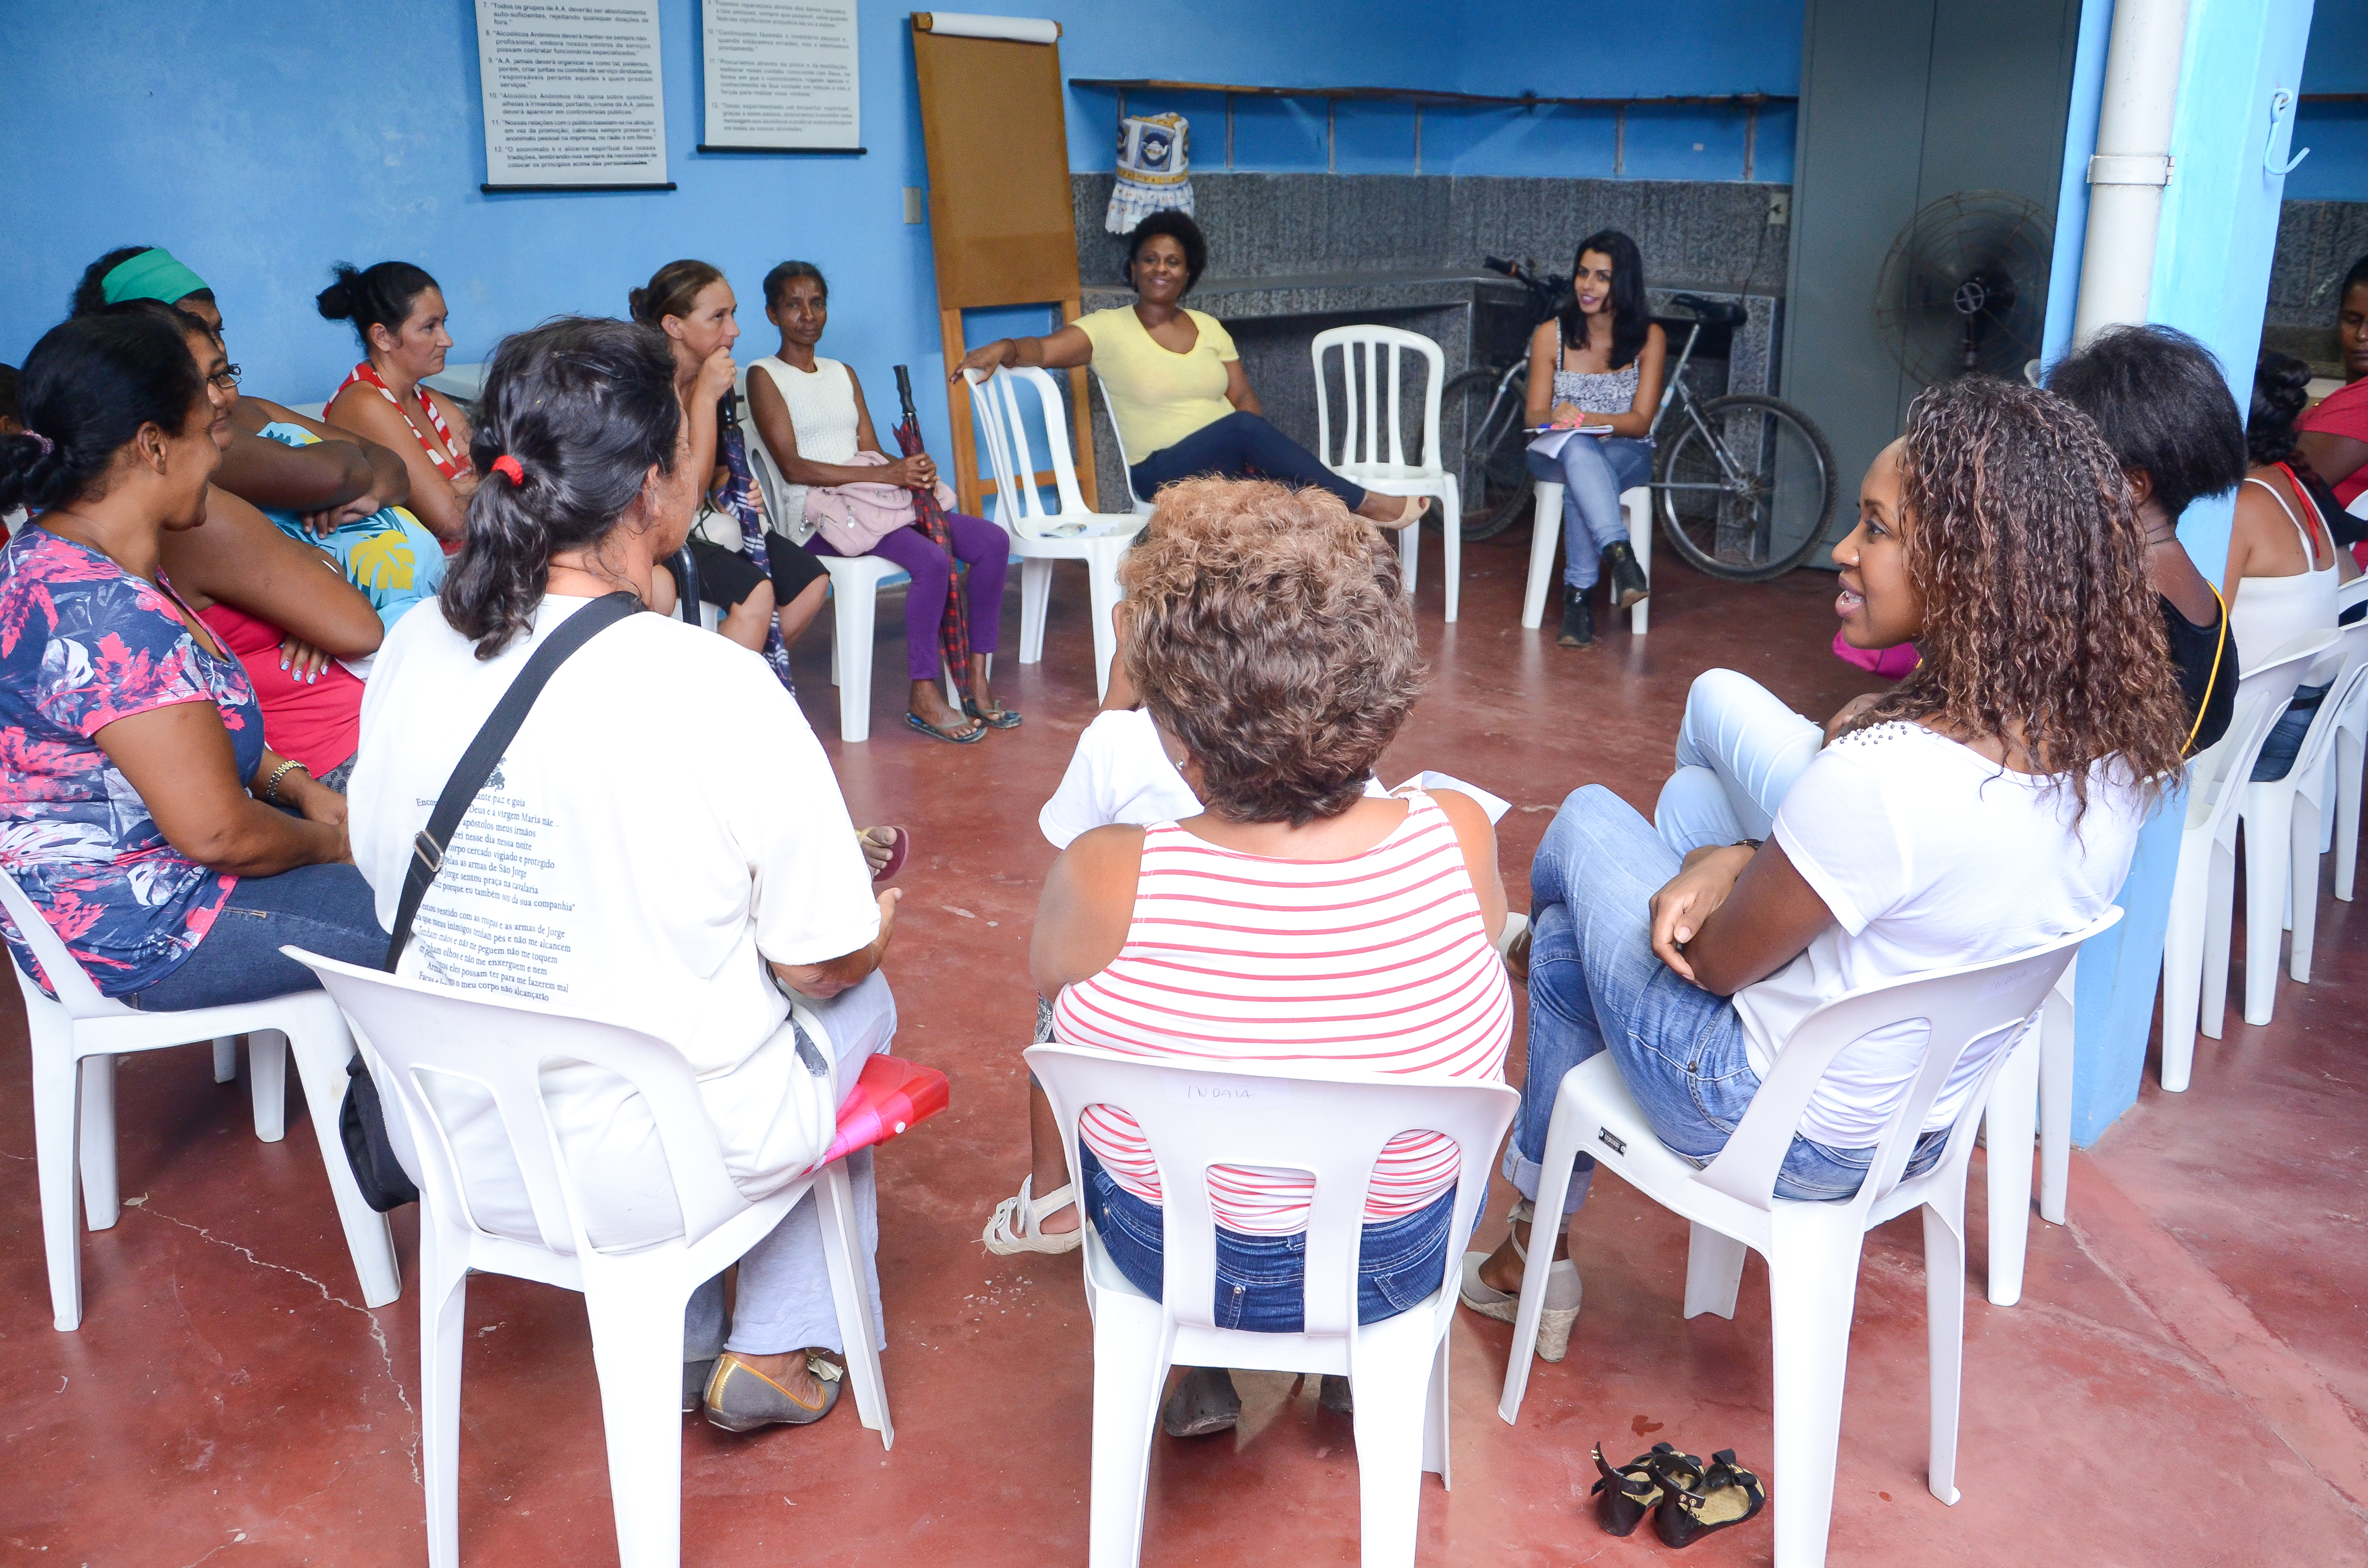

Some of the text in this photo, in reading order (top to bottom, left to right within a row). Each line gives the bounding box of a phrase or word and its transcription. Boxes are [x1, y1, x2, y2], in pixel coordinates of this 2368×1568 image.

[493, 796, 504, 805] paz
[512, 798, 525, 808] guia
[469, 805, 485, 814] Deus
[498, 810, 519, 821] virgem
[521, 813, 540, 824] Maria
[463, 820, 536, 837] apóstolos meus irmãos
[466, 833, 483, 842] nesse
[485, 834, 495, 843] dia
[497, 838, 514, 847] nessa
[516, 841, 532, 850] noite
[445, 855, 458, 865] pelas
[468, 862, 486, 870] armas
[489, 862, 497, 871] de
[499, 864, 510, 873] São
[511, 866, 526, 879] Jorge
[449, 845, 465, 855] corpo
[467, 848, 491, 857] cercado
[494, 851, 517, 862] vigiado
[524, 857, 555, 870] protegido
[444, 868, 459, 881] Jorge
[461, 873, 481, 882] sentou
[483, 878, 501, 887] praça
[512, 883, 538, 894] cavalaria
[443, 883, 463, 893] porque
[475, 888, 500, 899] também
[502, 894, 510, 902] sou
[512, 894, 518, 904] da
[422, 904, 435, 912] estou
[437, 908, 457, 917] vestido
[537, 925, 545, 934] de
[547, 927, 565, 939] Jorge
[418, 925, 437, 939] Tenham
[439, 934, 452, 943] mãos
[478, 945, 504, 956] peguem
[532, 953, 557, 963] toquem
[448, 921, 472, 935] inimigos
[494, 935, 505, 944] pés
[539, 939, 571, 952] alcancem
[443, 947, 459, 958] olhos
[464, 955, 474, 963] não
[488, 960, 525, 970] enxerguem
[533, 967, 547, 975] nem
[450, 963, 460, 973] eles
[461, 968, 487, 977] possam
[501, 974, 515, 982] para
[528, 977, 555, 990] fazerem
[558, 984, 568, 993] mal
[478, 983, 499, 992] corpo
[514, 987, 549, 1001] alcançarão
